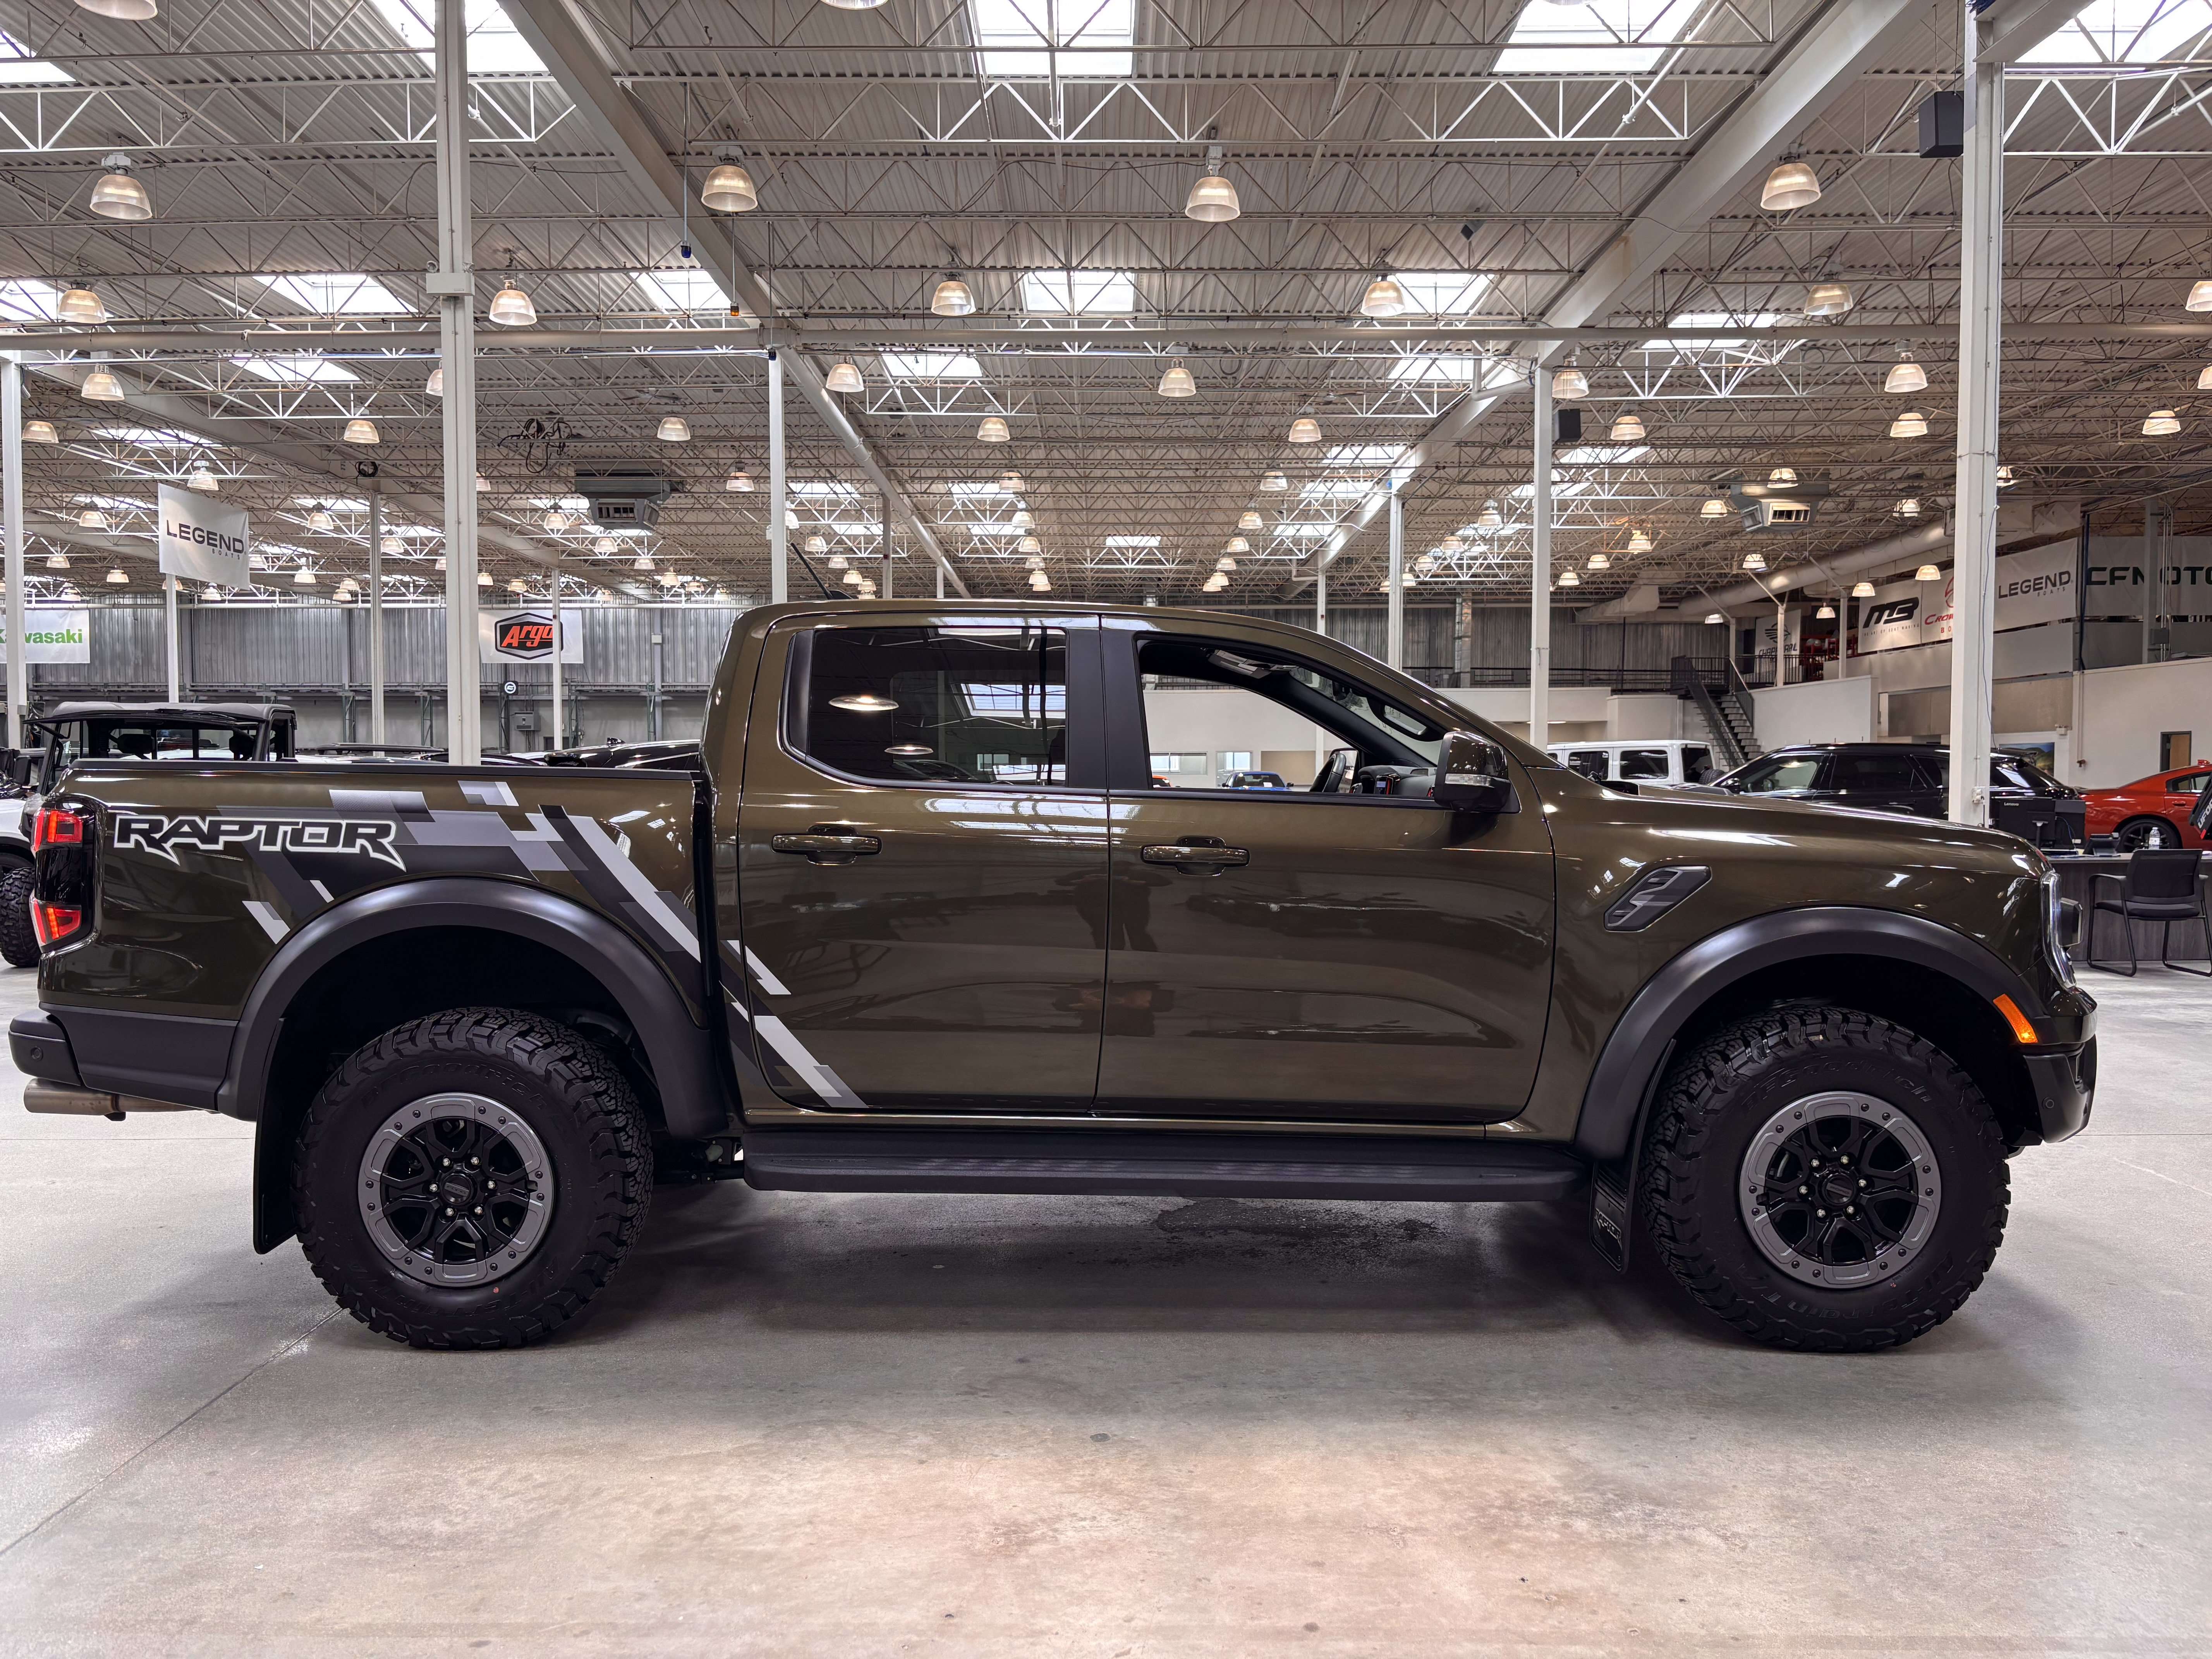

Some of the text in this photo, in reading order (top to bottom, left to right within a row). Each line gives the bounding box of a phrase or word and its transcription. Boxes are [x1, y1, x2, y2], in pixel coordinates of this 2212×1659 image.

[167, 519, 244, 554] LEGEND
[212, 548, 240, 560] BOATS
[1998, 570, 2071, 599] LEGEND
[2037, 586, 2066, 597] BOATS
[0, 629, 83, 644] asaki
[113, 814, 407, 872] RAPTOR
